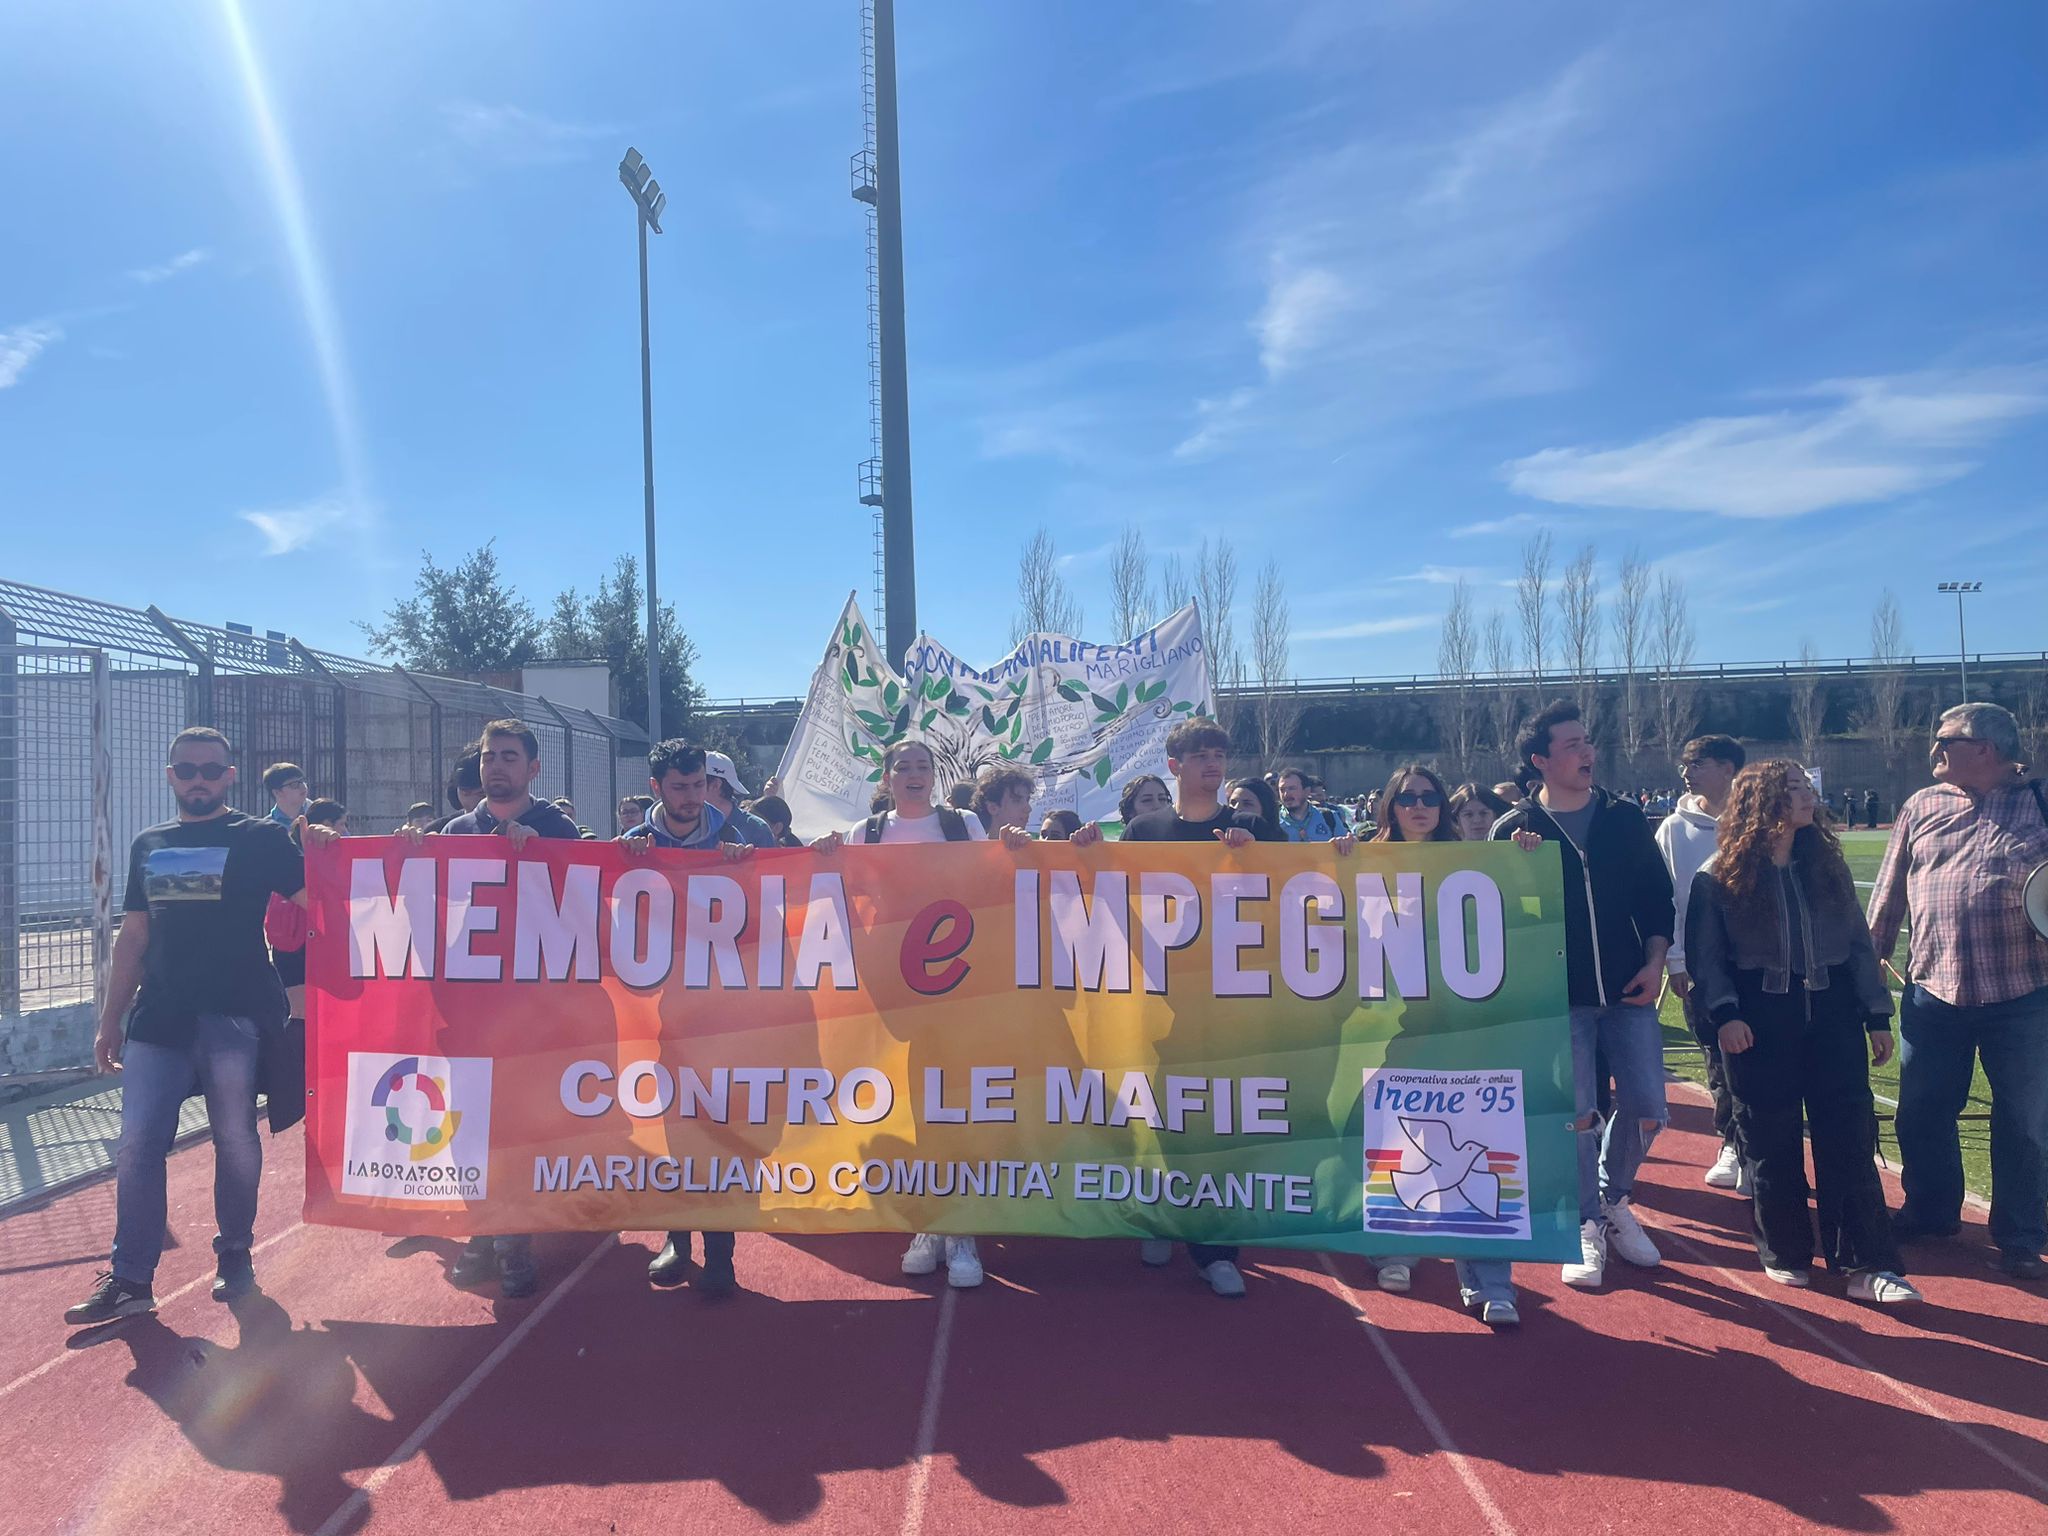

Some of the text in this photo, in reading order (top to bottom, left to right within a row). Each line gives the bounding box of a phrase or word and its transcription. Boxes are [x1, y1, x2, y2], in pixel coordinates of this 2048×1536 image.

[1085, 637, 1201, 681] MARIGLIANO
[1049, 704, 1074, 715] AMORE
[814, 737, 828, 748] LA
[1033, 729, 1051, 741] NON
[1110, 730, 1145, 747] ALZIAMO
[1146, 727, 1156, 736] LA
[811, 747, 830, 763] TEME
[1119, 752, 1137, 760] NON
[1134, 758, 1164, 770] OCCHI
[805, 770, 851, 798] GIUSTIZIA
[823, 766, 846, 785] DELLA
[349, 857, 1507, 1001] MEMORIA e IMPEGNO
[1389, 1074, 1448, 1085] cooperativa
[1450, 1075, 1481, 1085] sociale
[1488, 1074, 1514, 1084] onlus
[559, 1060, 1291, 1135] CONTRO LE MAFIE
[1373, 1079, 1466, 1114] Irene
[348, 1160, 481, 1182] LABORATORIO
[404, 1183, 480, 1197] DI COMUNITÀ
[532, 1154, 1313, 1214] MARIGLIANO COMUNITA' EDUCANTE
